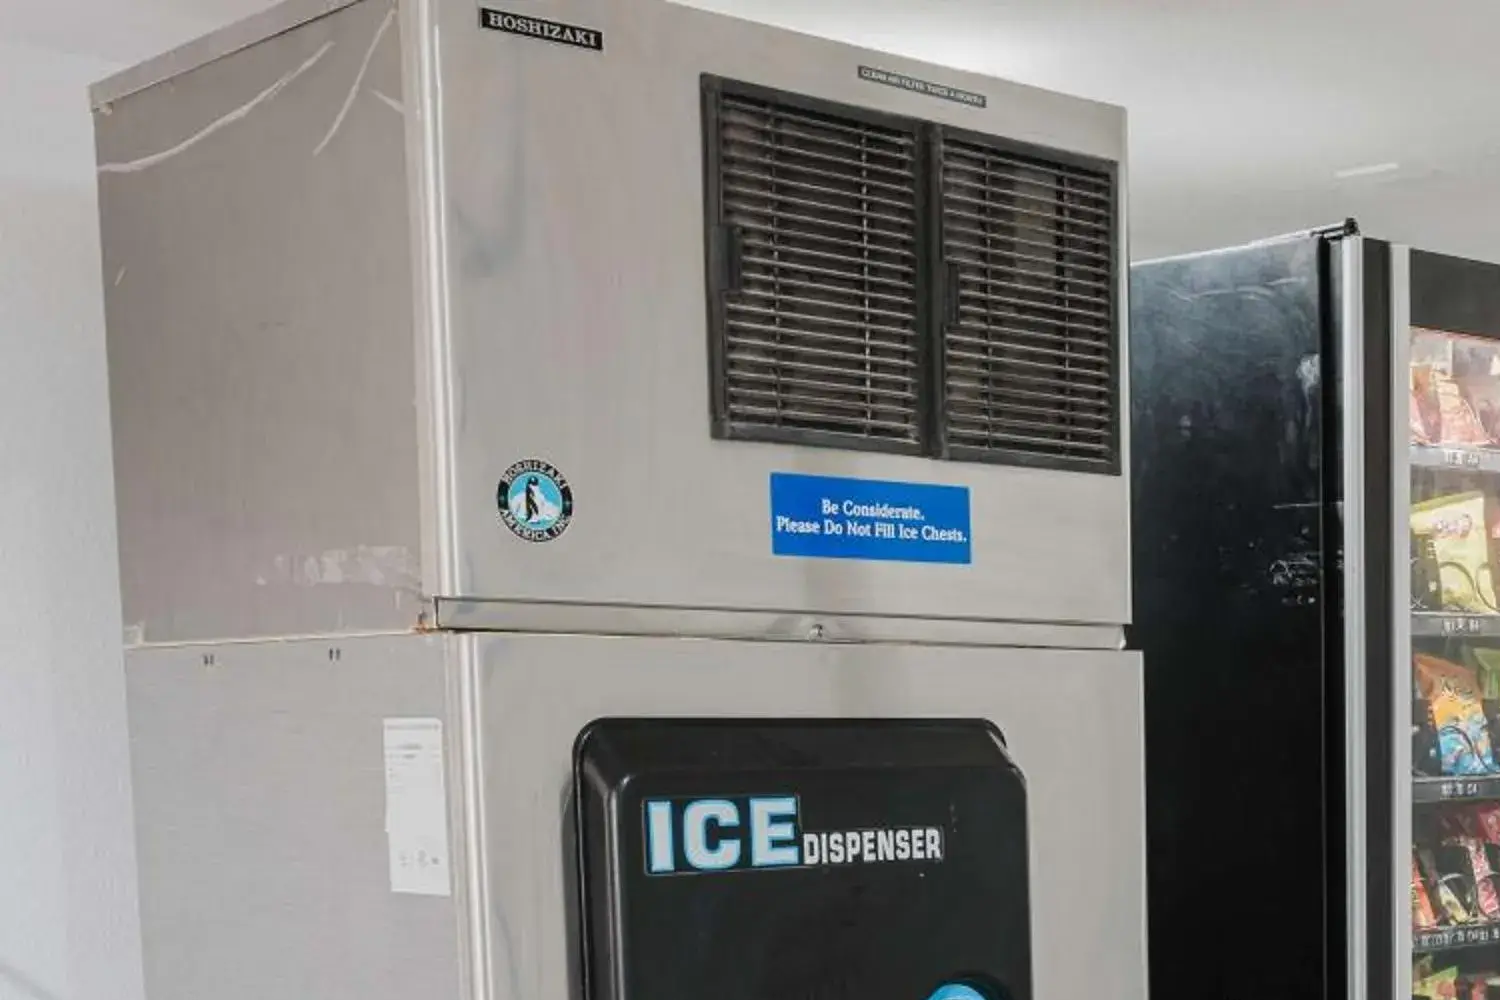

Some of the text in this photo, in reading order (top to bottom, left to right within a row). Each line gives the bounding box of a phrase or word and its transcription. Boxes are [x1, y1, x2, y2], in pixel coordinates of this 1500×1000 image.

[488, 11, 597, 47] HOSHIZAKI
[821, 498, 925, 521] Be Considerate.
[776, 516, 967, 543] Please Do Not Fill Ice Chests.
[647, 797, 942, 872] ICE DISPENSER
